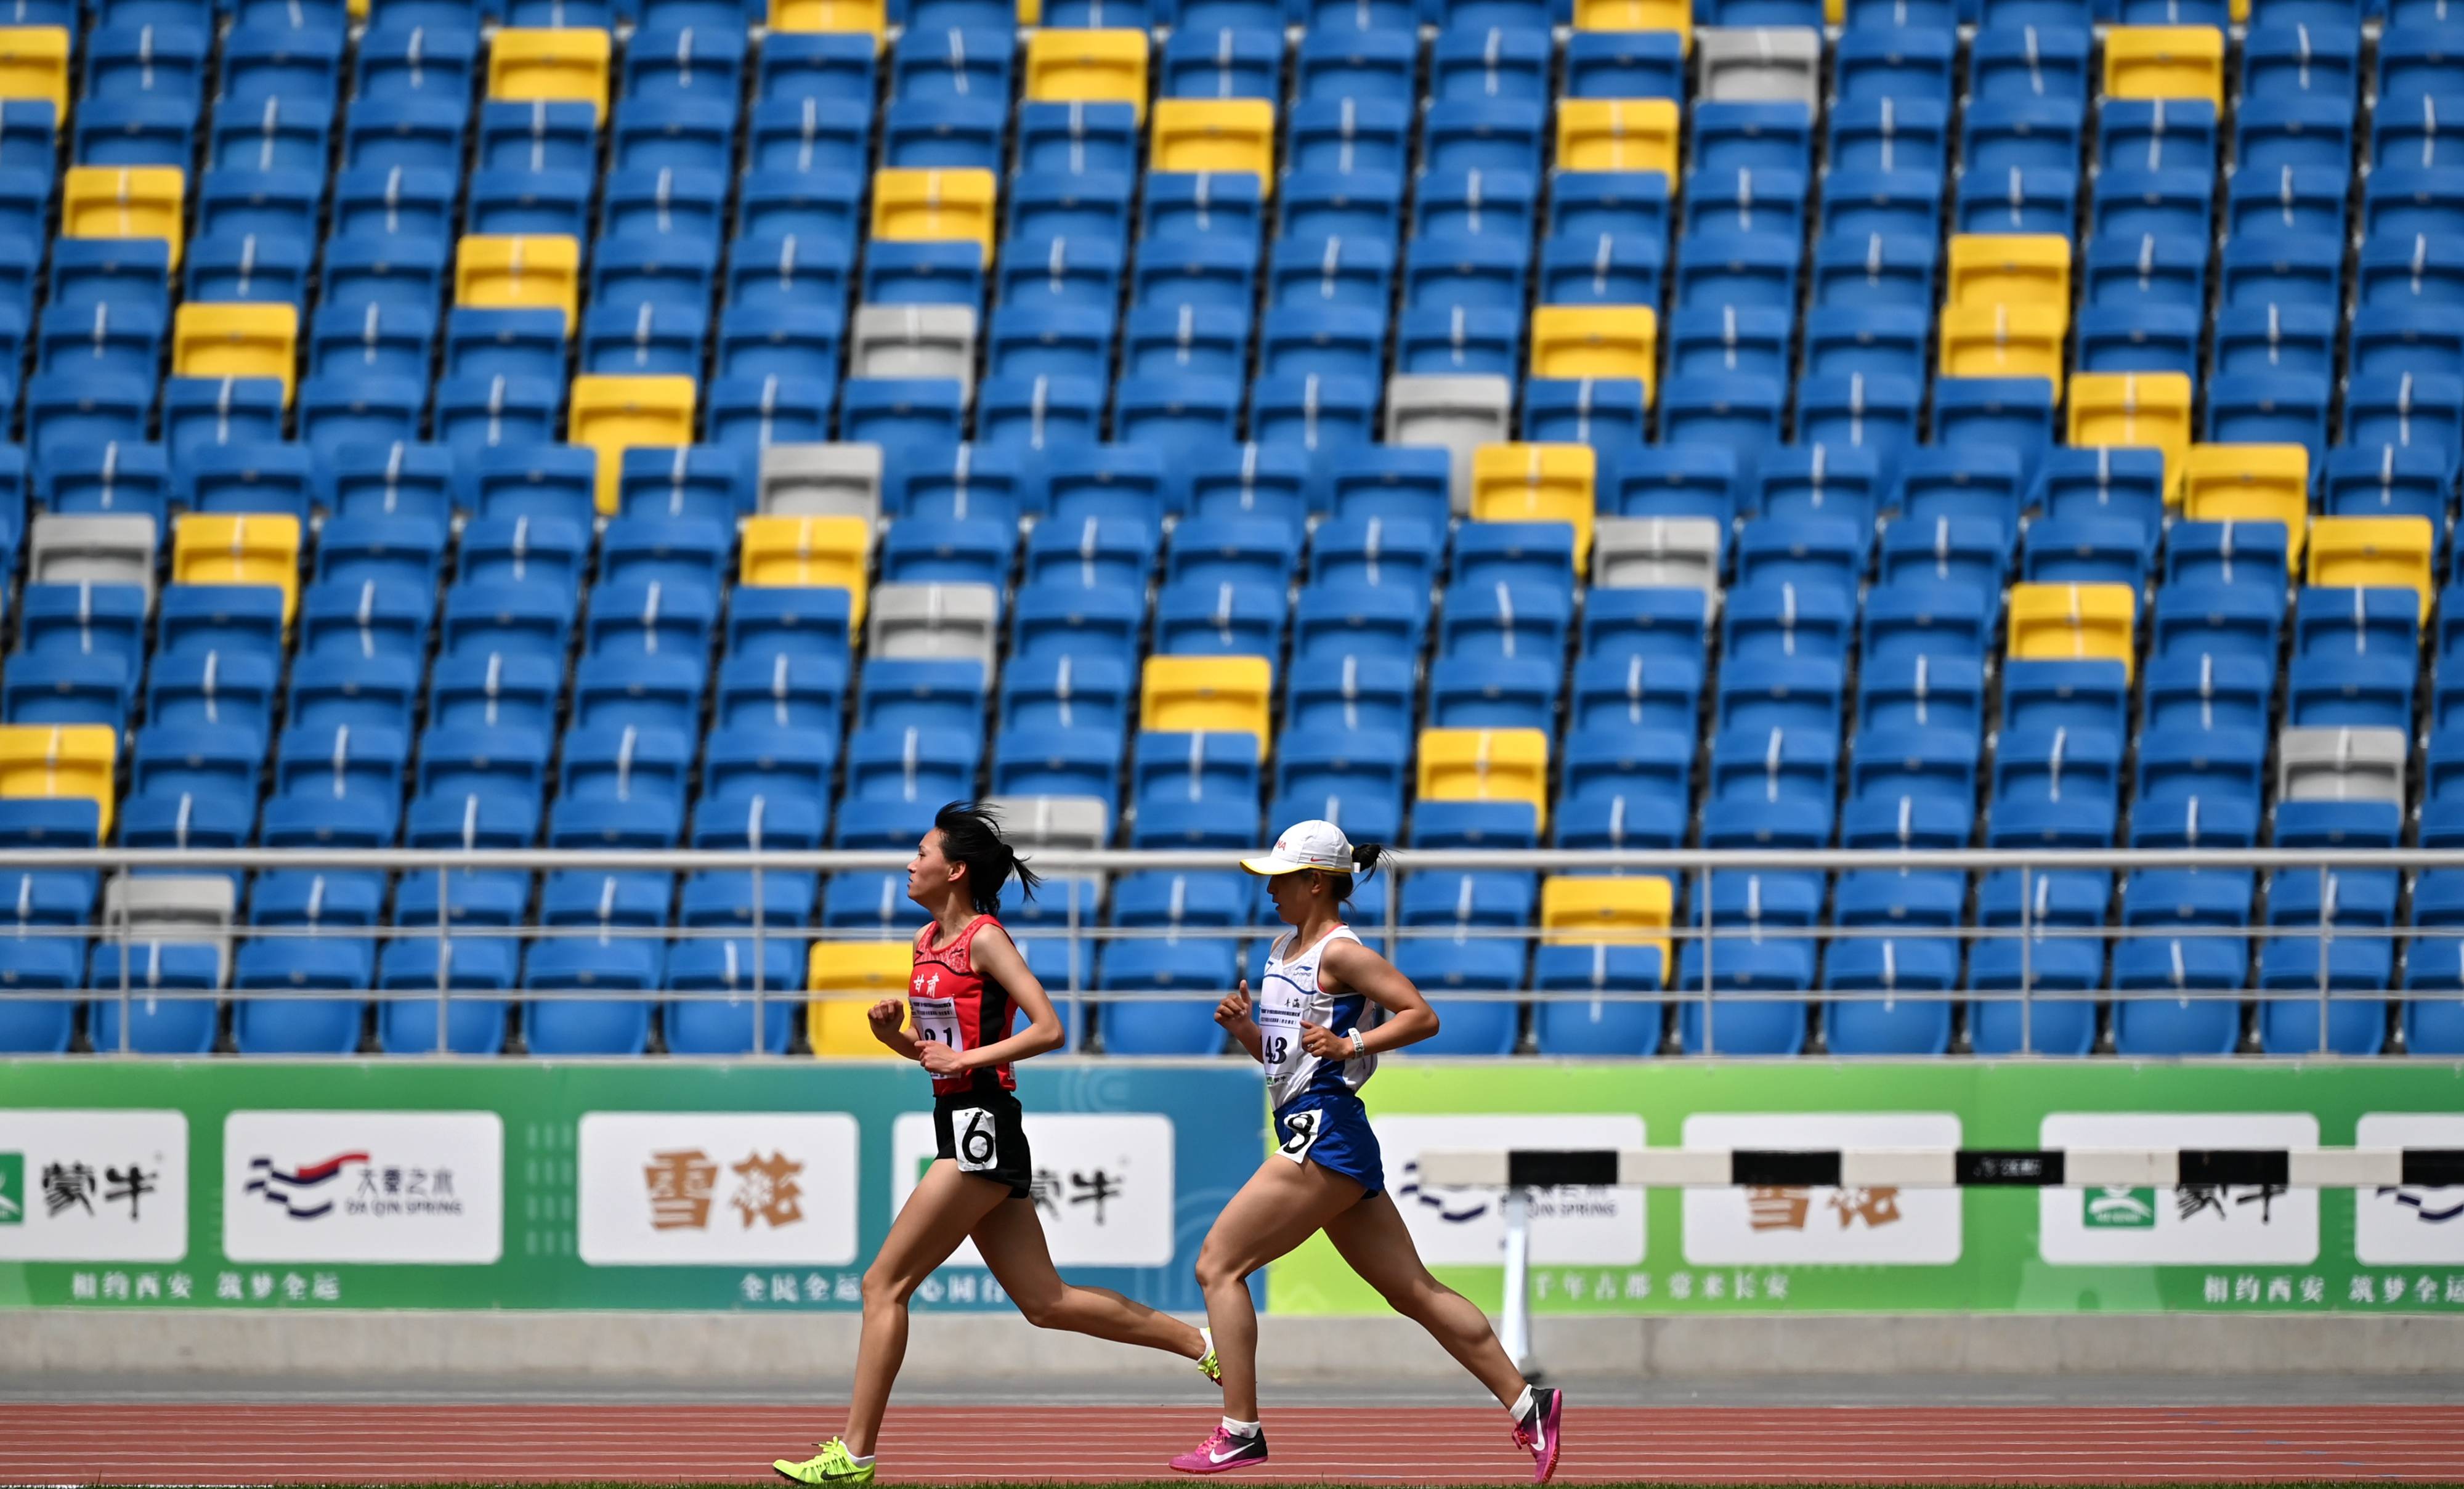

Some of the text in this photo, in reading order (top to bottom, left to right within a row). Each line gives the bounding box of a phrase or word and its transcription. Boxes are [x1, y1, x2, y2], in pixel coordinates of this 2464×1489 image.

[914, 973, 939, 998] 甘肃
[1265, 1036, 1287, 1065] 43
[962, 1111, 994, 1164] 6
[41, 1161, 158, 1220] 蒙牛
[642, 1149, 804, 1230] 雪花
[72, 1270, 193, 1300] 相约西安
[918, 1274, 1005, 1303] 心同行
[2203, 1275, 2325, 1303] 相约西安
